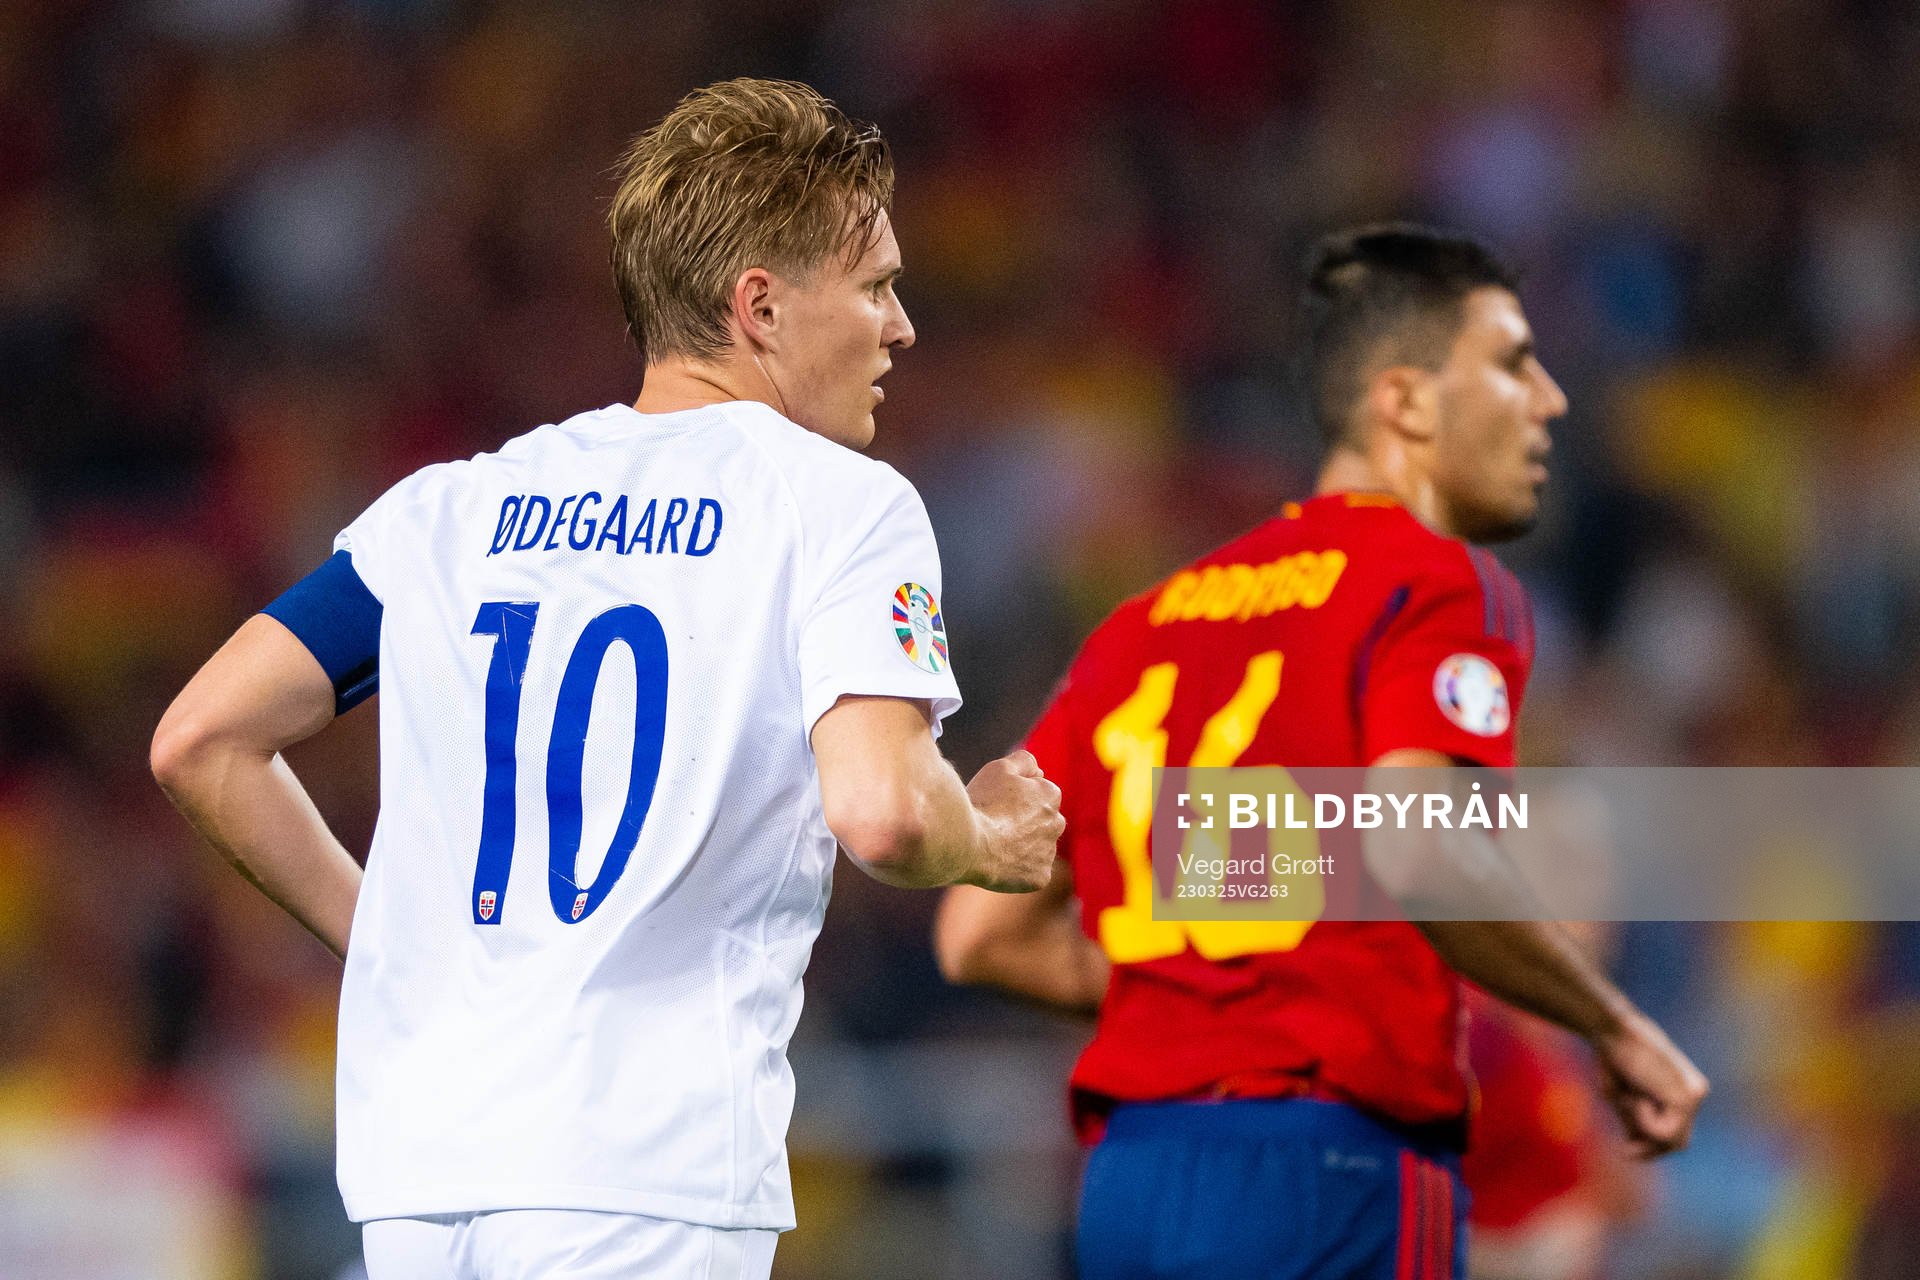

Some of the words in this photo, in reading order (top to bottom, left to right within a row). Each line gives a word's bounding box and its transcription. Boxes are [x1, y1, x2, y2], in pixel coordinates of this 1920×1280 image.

[487, 491, 723, 557] ØDEGAARD
[470, 601, 669, 925] 10
[1092, 650, 1326, 964] 16
